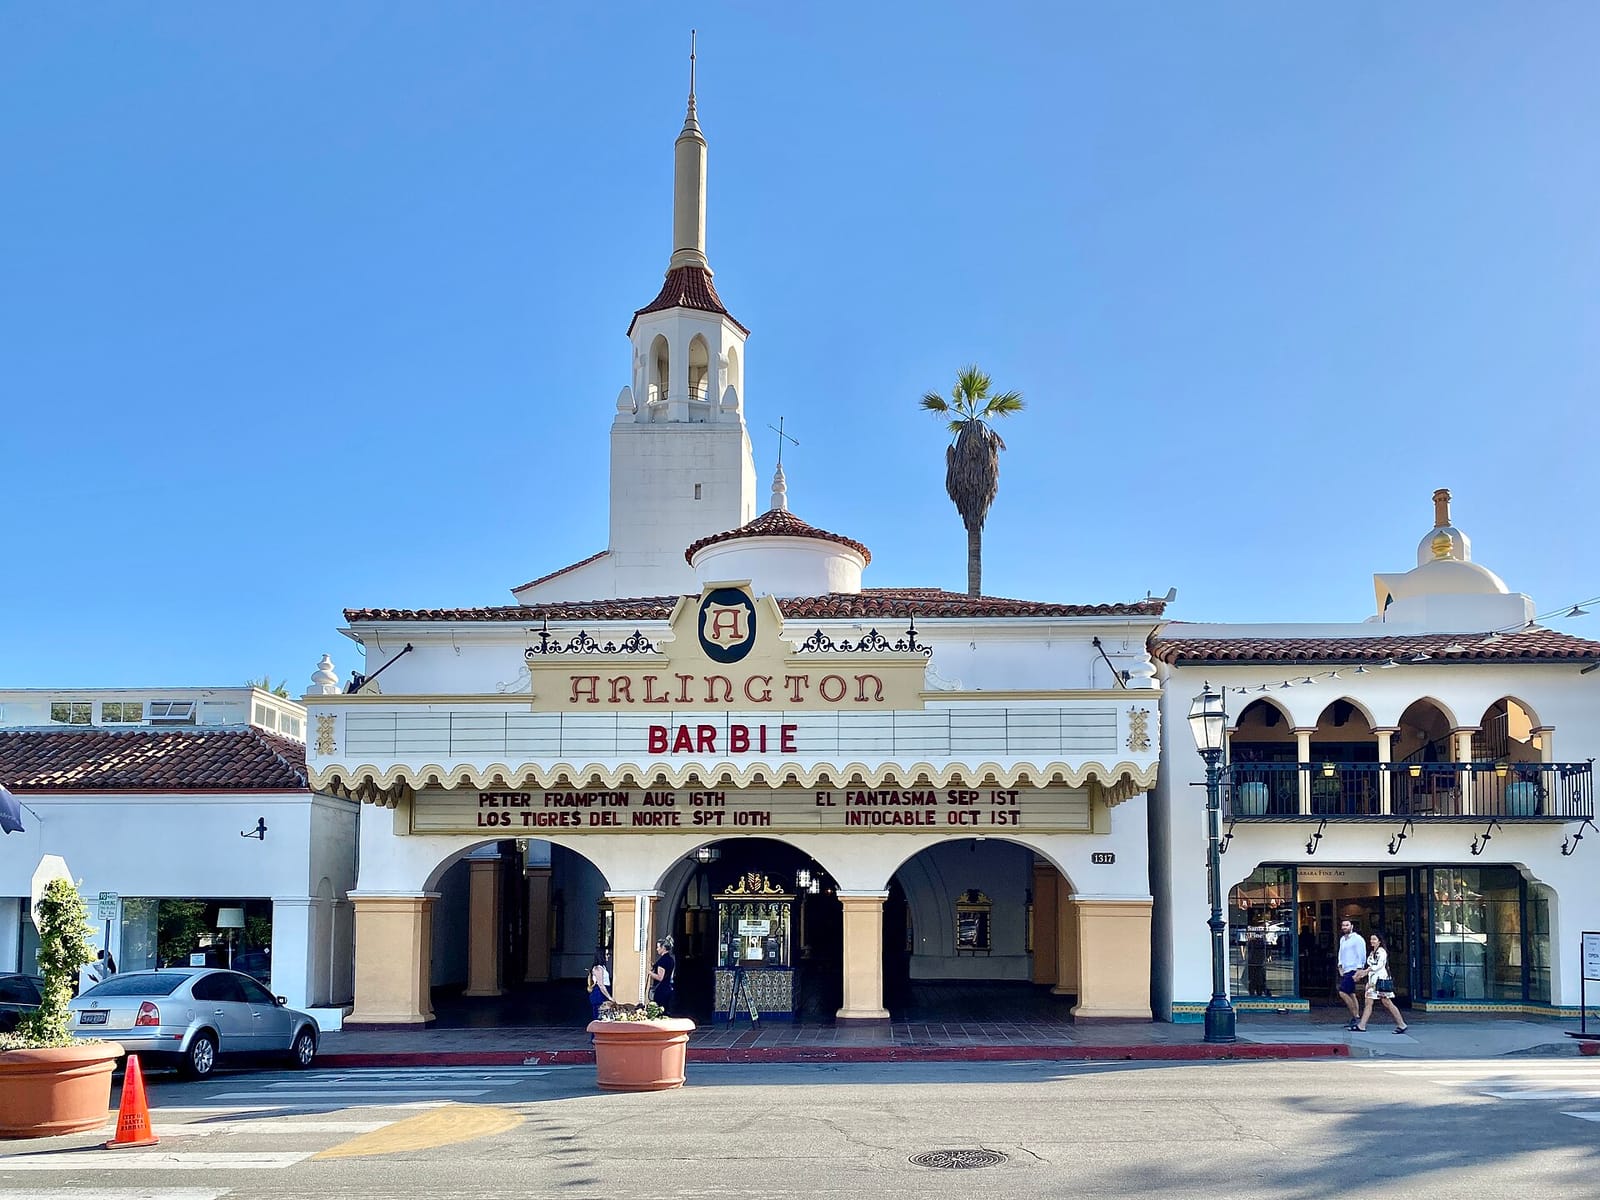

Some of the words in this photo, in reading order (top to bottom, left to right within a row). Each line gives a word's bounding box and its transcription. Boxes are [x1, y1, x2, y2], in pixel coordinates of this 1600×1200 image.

[712, 609, 743, 639] A
[569, 673, 885, 703] ARLINGTON
[648, 725, 798, 754] BARBIE
[479, 792, 530, 807] PETER
[544, 792, 629, 807] FRAMPTON
[643, 793, 675, 807] AUG
[689, 792, 725, 807] 16TH
[816, 792, 836, 806] EL
[846, 791, 937, 806] FANTASMA
[947, 790, 980, 806] SEP
[478, 812, 511, 827] LOS
[520, 812, 581, 827] TIGRES
[589, 812, 622, 827] DEL
[632, 812, 681, 827] NORTE
[692, 811, 725, 827] SPT
[845, 811, 936, 826] INTOCABLE
[947, 811, 981, 826] OCT
[1095, 854, 1113, 863] 1317
